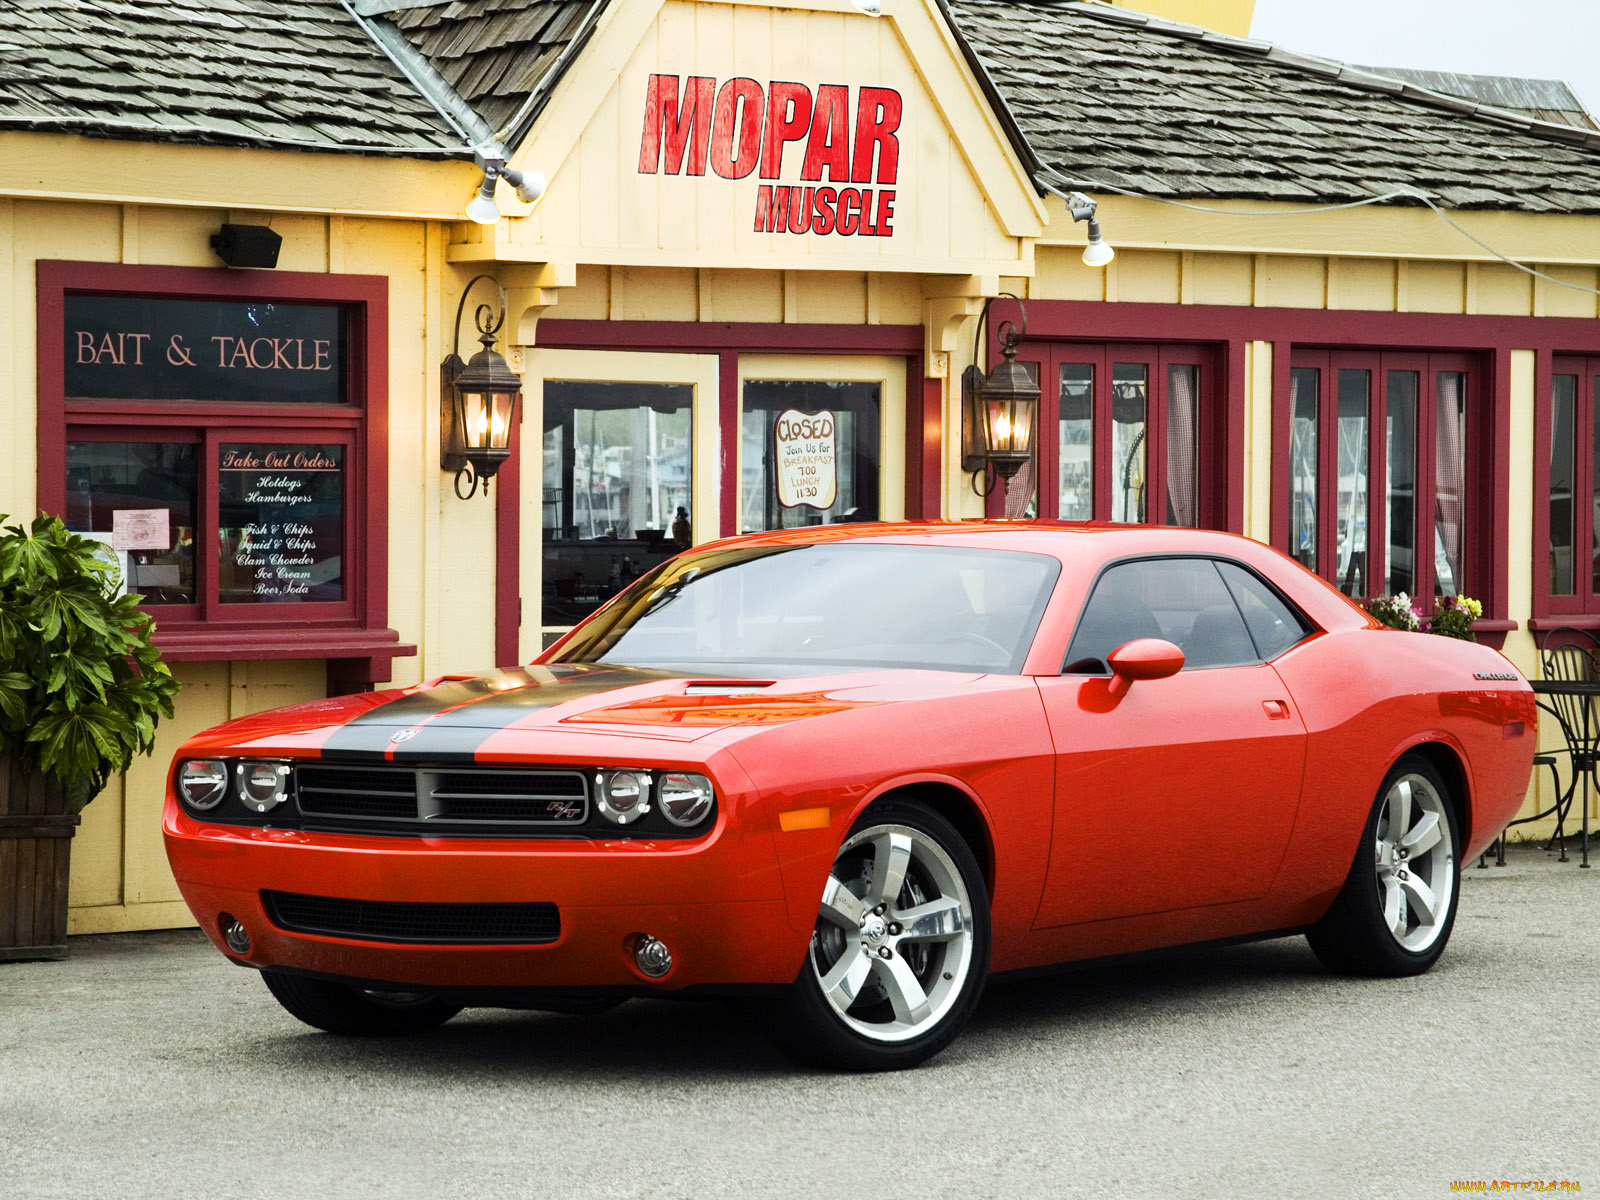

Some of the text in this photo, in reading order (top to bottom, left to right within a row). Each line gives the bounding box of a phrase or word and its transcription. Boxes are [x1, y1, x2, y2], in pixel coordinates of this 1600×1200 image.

[638, 73, 903, 185] MOPAR
[753, 184, 896, 237] MUSCLE
[75, 331, 332, 371] BAIT & TACKLE
[777, 418, 833, 442] CLOSED
[786, 445, 803, 456] Join
[805, 443, 816, 454] Us
[293, 451, 336, 468] Orders
[783, 455, 833, 468] BREAKFAST
[256, 475, 302, 491] Hotdogs
[790, 477, 820, 487] LUNCH
[244, 491, 312, 506] Hamburgers
[244, 522, 314, 538] Fish & Chips
[238, 537, 316, 554] Squid & Chips
[235, 554, 314, 566] Clam Chowder
[254, 567, 310, 579] Ice Cream
[546, 801, 581, 818] R/T
